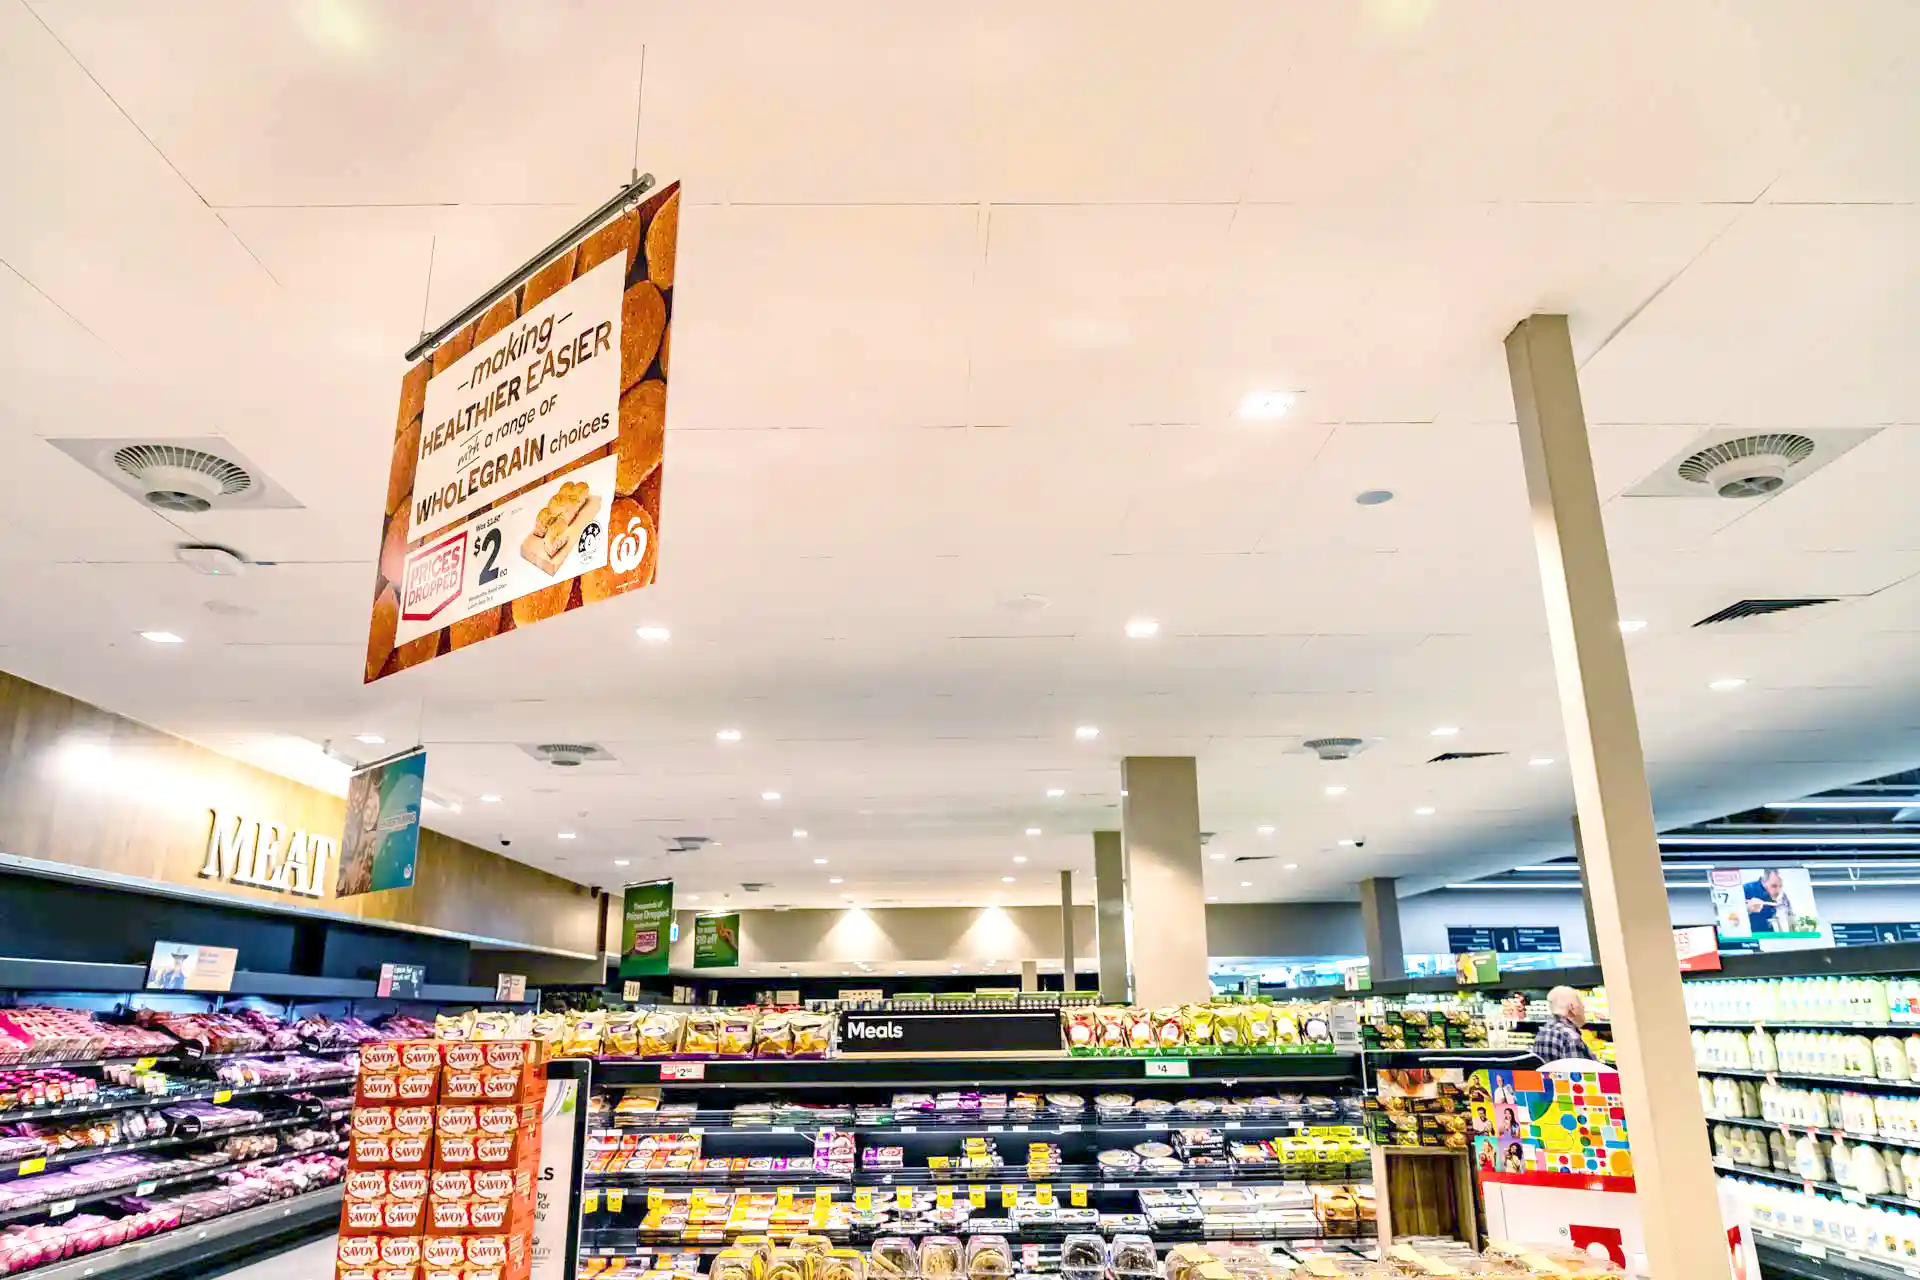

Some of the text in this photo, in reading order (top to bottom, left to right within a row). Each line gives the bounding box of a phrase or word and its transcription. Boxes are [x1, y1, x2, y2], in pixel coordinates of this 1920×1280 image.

[470, 313, 555, 390] making
[421, 320, 612, 460] HEALTHIER EASIER
[484, 433, 493, 449] a
[495, 411, 536, 442] range
[416, 412, 610, 525] WHOLEGRAIN choices
[410, 545, 461, 590] PRICES
[407, 570, 458, 607] DROPPED
[198, 807, 337, 899] MEAT
[1501, 937, 1509, 951] 1
[847, 1021, 903, 1039] Meals
[364, 1052, 397, 1064] SAVOY
[405, 1052, 438, 1064] SAVOY
[449, 1052, 482, 1063] SAVOY
[488, 1051, 522, 1063] SAVOY
[357, 1115, 391, 1127] SAVOY
[398, 1115, 430, 1127] SAVOY
[441, 1115, 474, 1127] SAVOY
[481, 1114, 515, 1127] SAVOY
[350, 1180, 384, 1192] SAVOY
[391, 1179, 425, 1191] SAVOY
[435, 1180, 469, 1192] SAVOY
[476, 1179, 510, 1191] SAVOY
[537, 1191, 548, 1202] by
[537, 1201, 550, 1210] for
[341, 1246, 376, 1258] SAVOY
[383, 1246, 417, 1258] SAVOY
[427, 1246, 461, 1258] SAVOY
[470, 1246, 504, 1258] SAVOY
